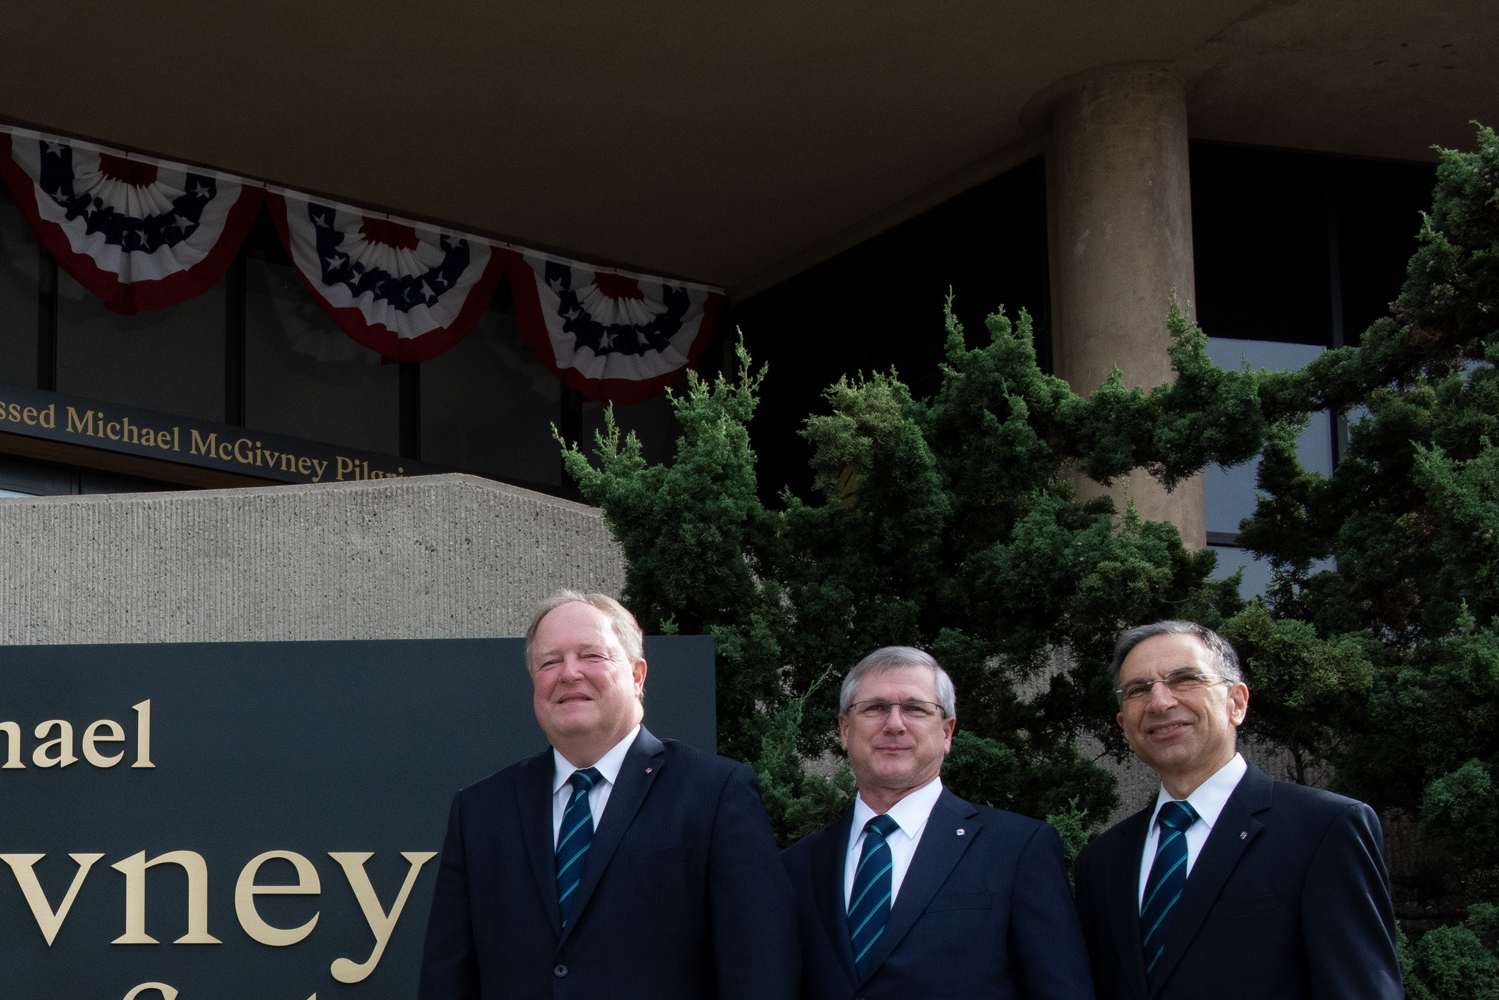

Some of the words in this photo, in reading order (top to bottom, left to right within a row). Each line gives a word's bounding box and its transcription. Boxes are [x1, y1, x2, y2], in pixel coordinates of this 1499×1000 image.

[66, 406, 180, 451] Michael
[189, 429, 329, 483] McGivney
[335, 455, 404, 481] Pil
